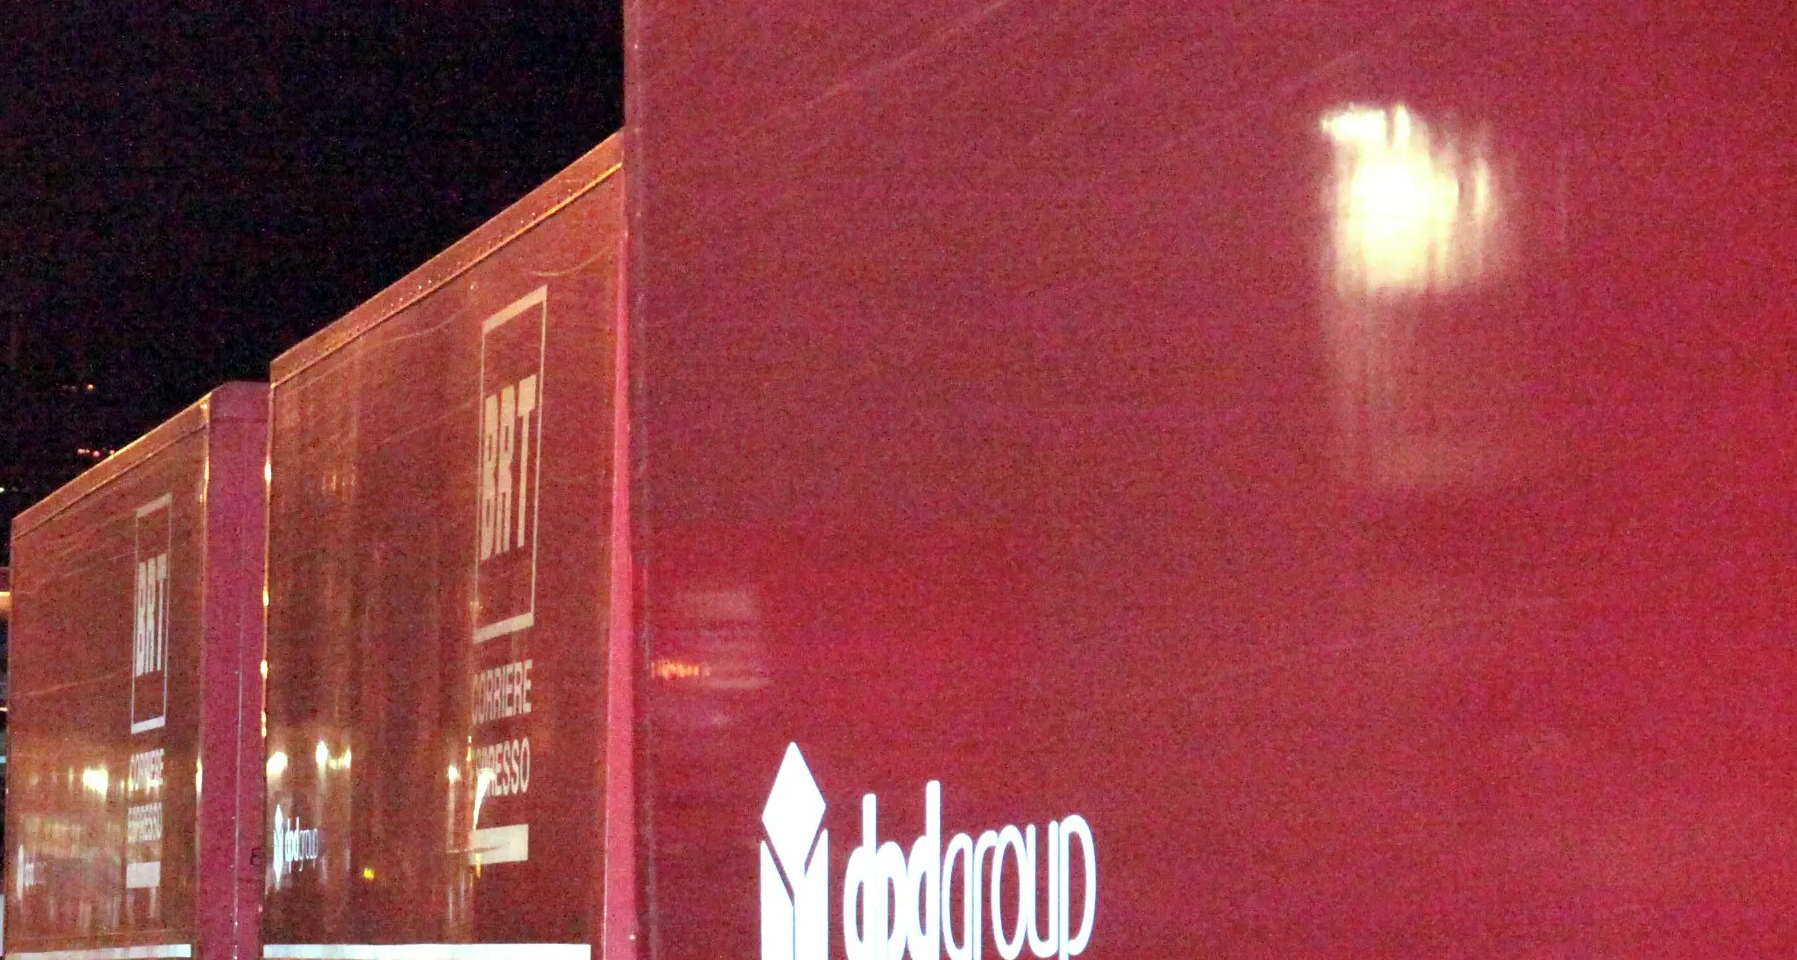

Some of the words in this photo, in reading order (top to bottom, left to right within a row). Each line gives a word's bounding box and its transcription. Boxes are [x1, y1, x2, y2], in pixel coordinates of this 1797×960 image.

[480, 374, 537, 561] BRT
[135, 552, 167, 677] BRT
[471, 659, 533, 725] CORRIERE
